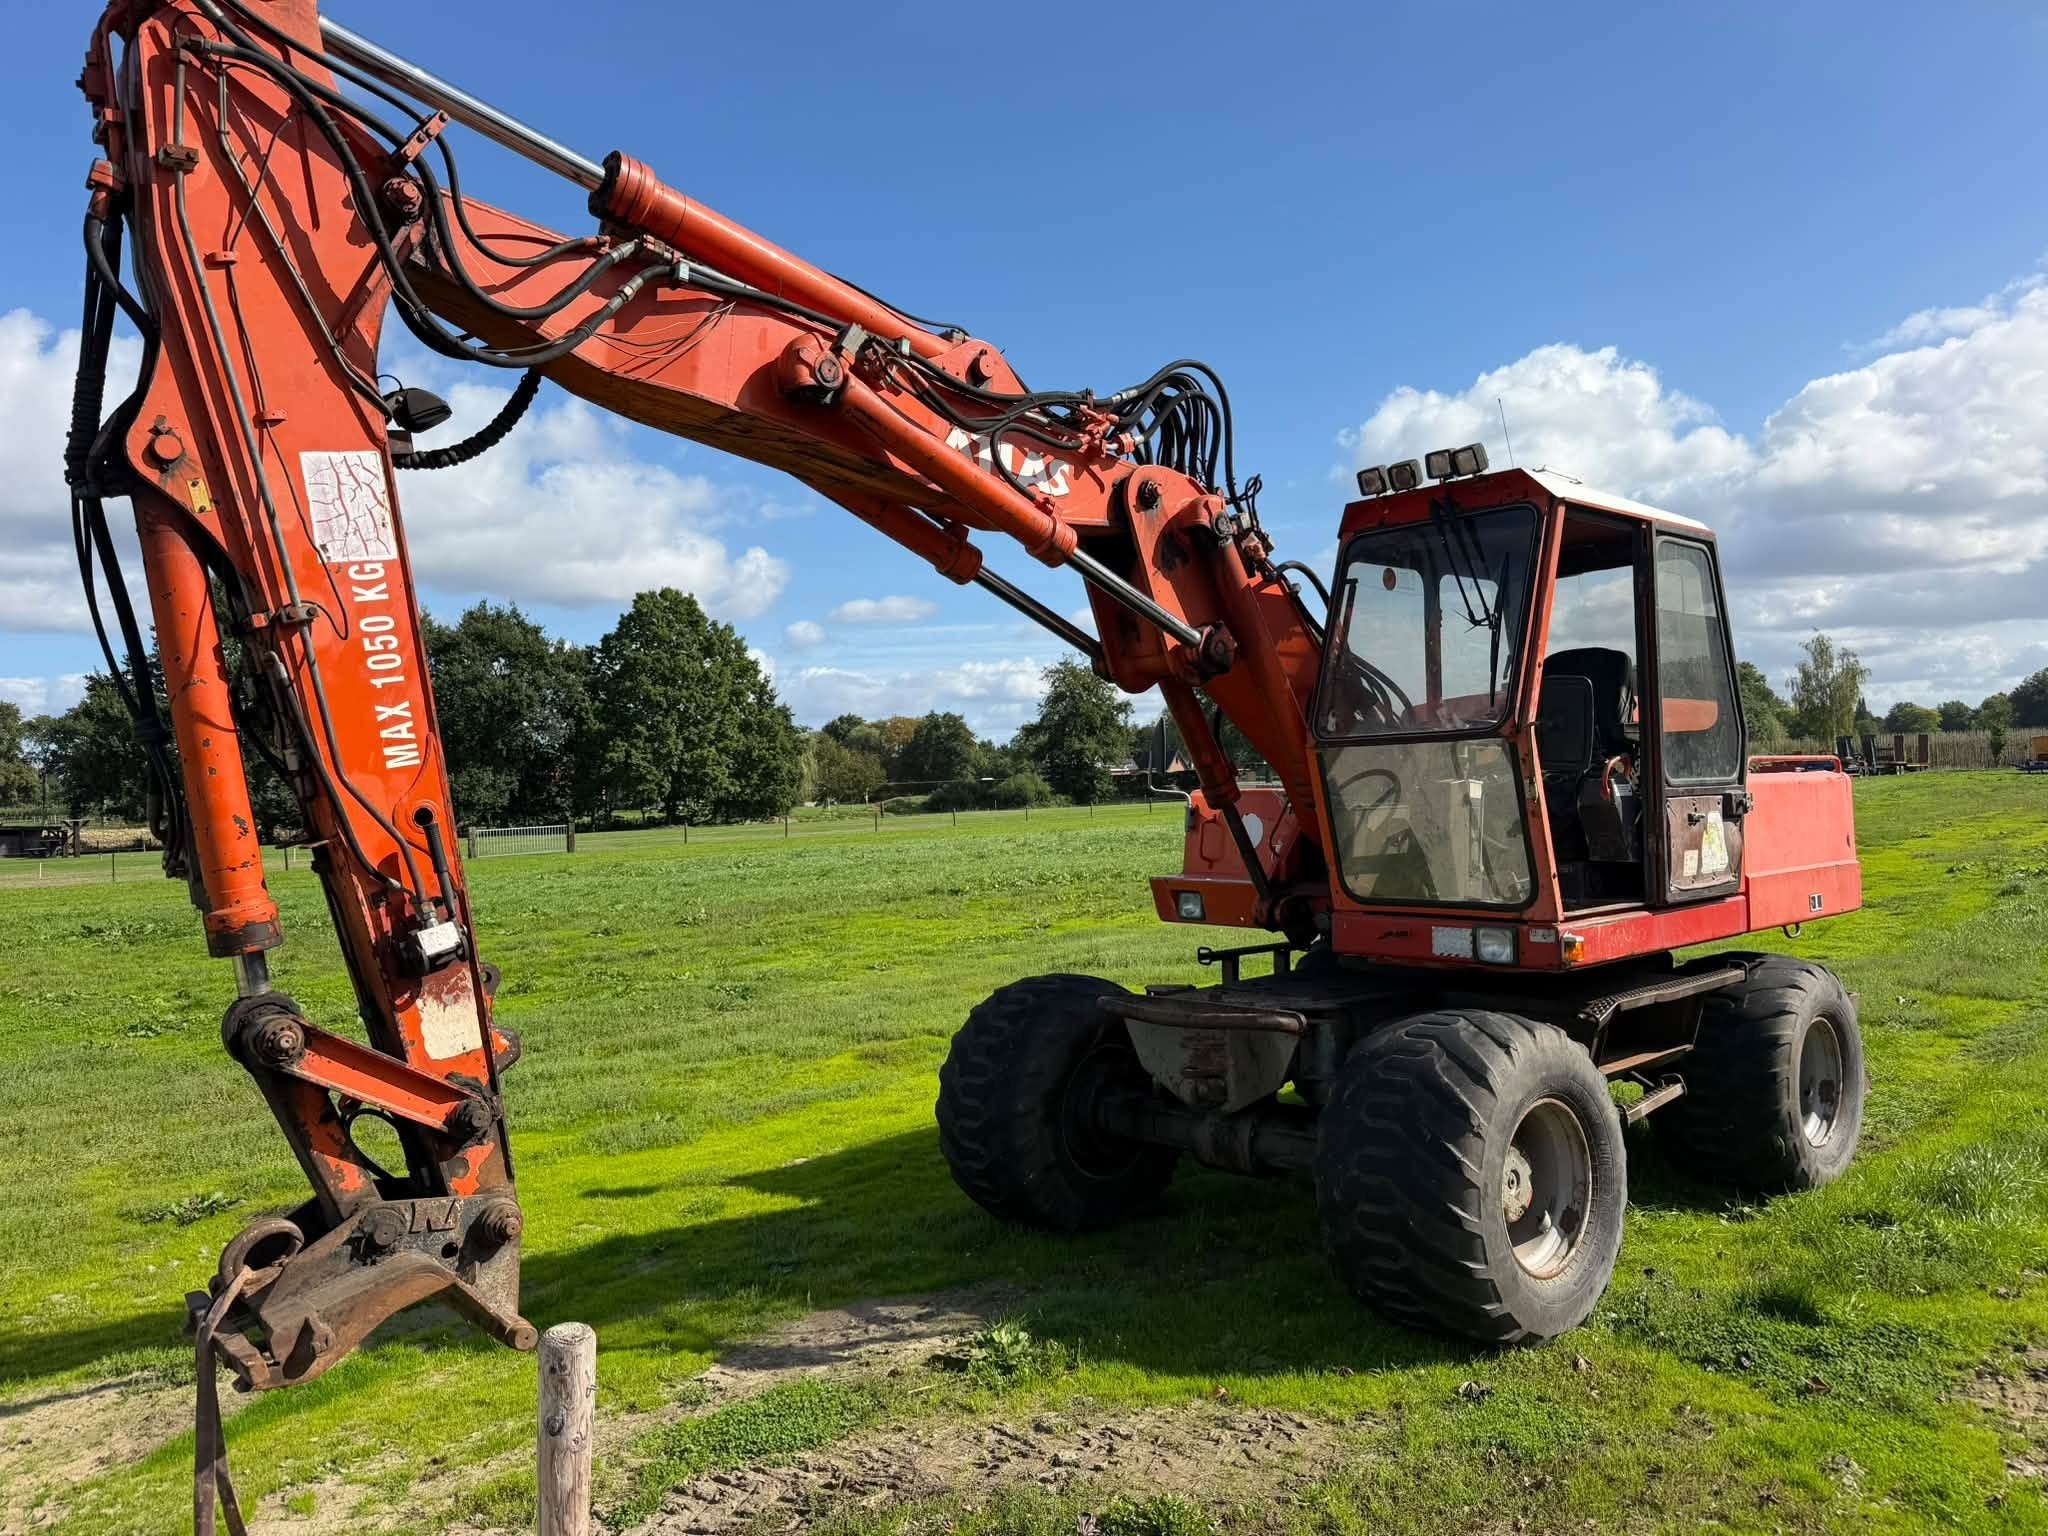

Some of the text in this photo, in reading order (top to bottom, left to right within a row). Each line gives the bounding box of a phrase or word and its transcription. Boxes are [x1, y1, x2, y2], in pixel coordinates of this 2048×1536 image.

[348, 562, 421, 769] MAX 1050 KG
